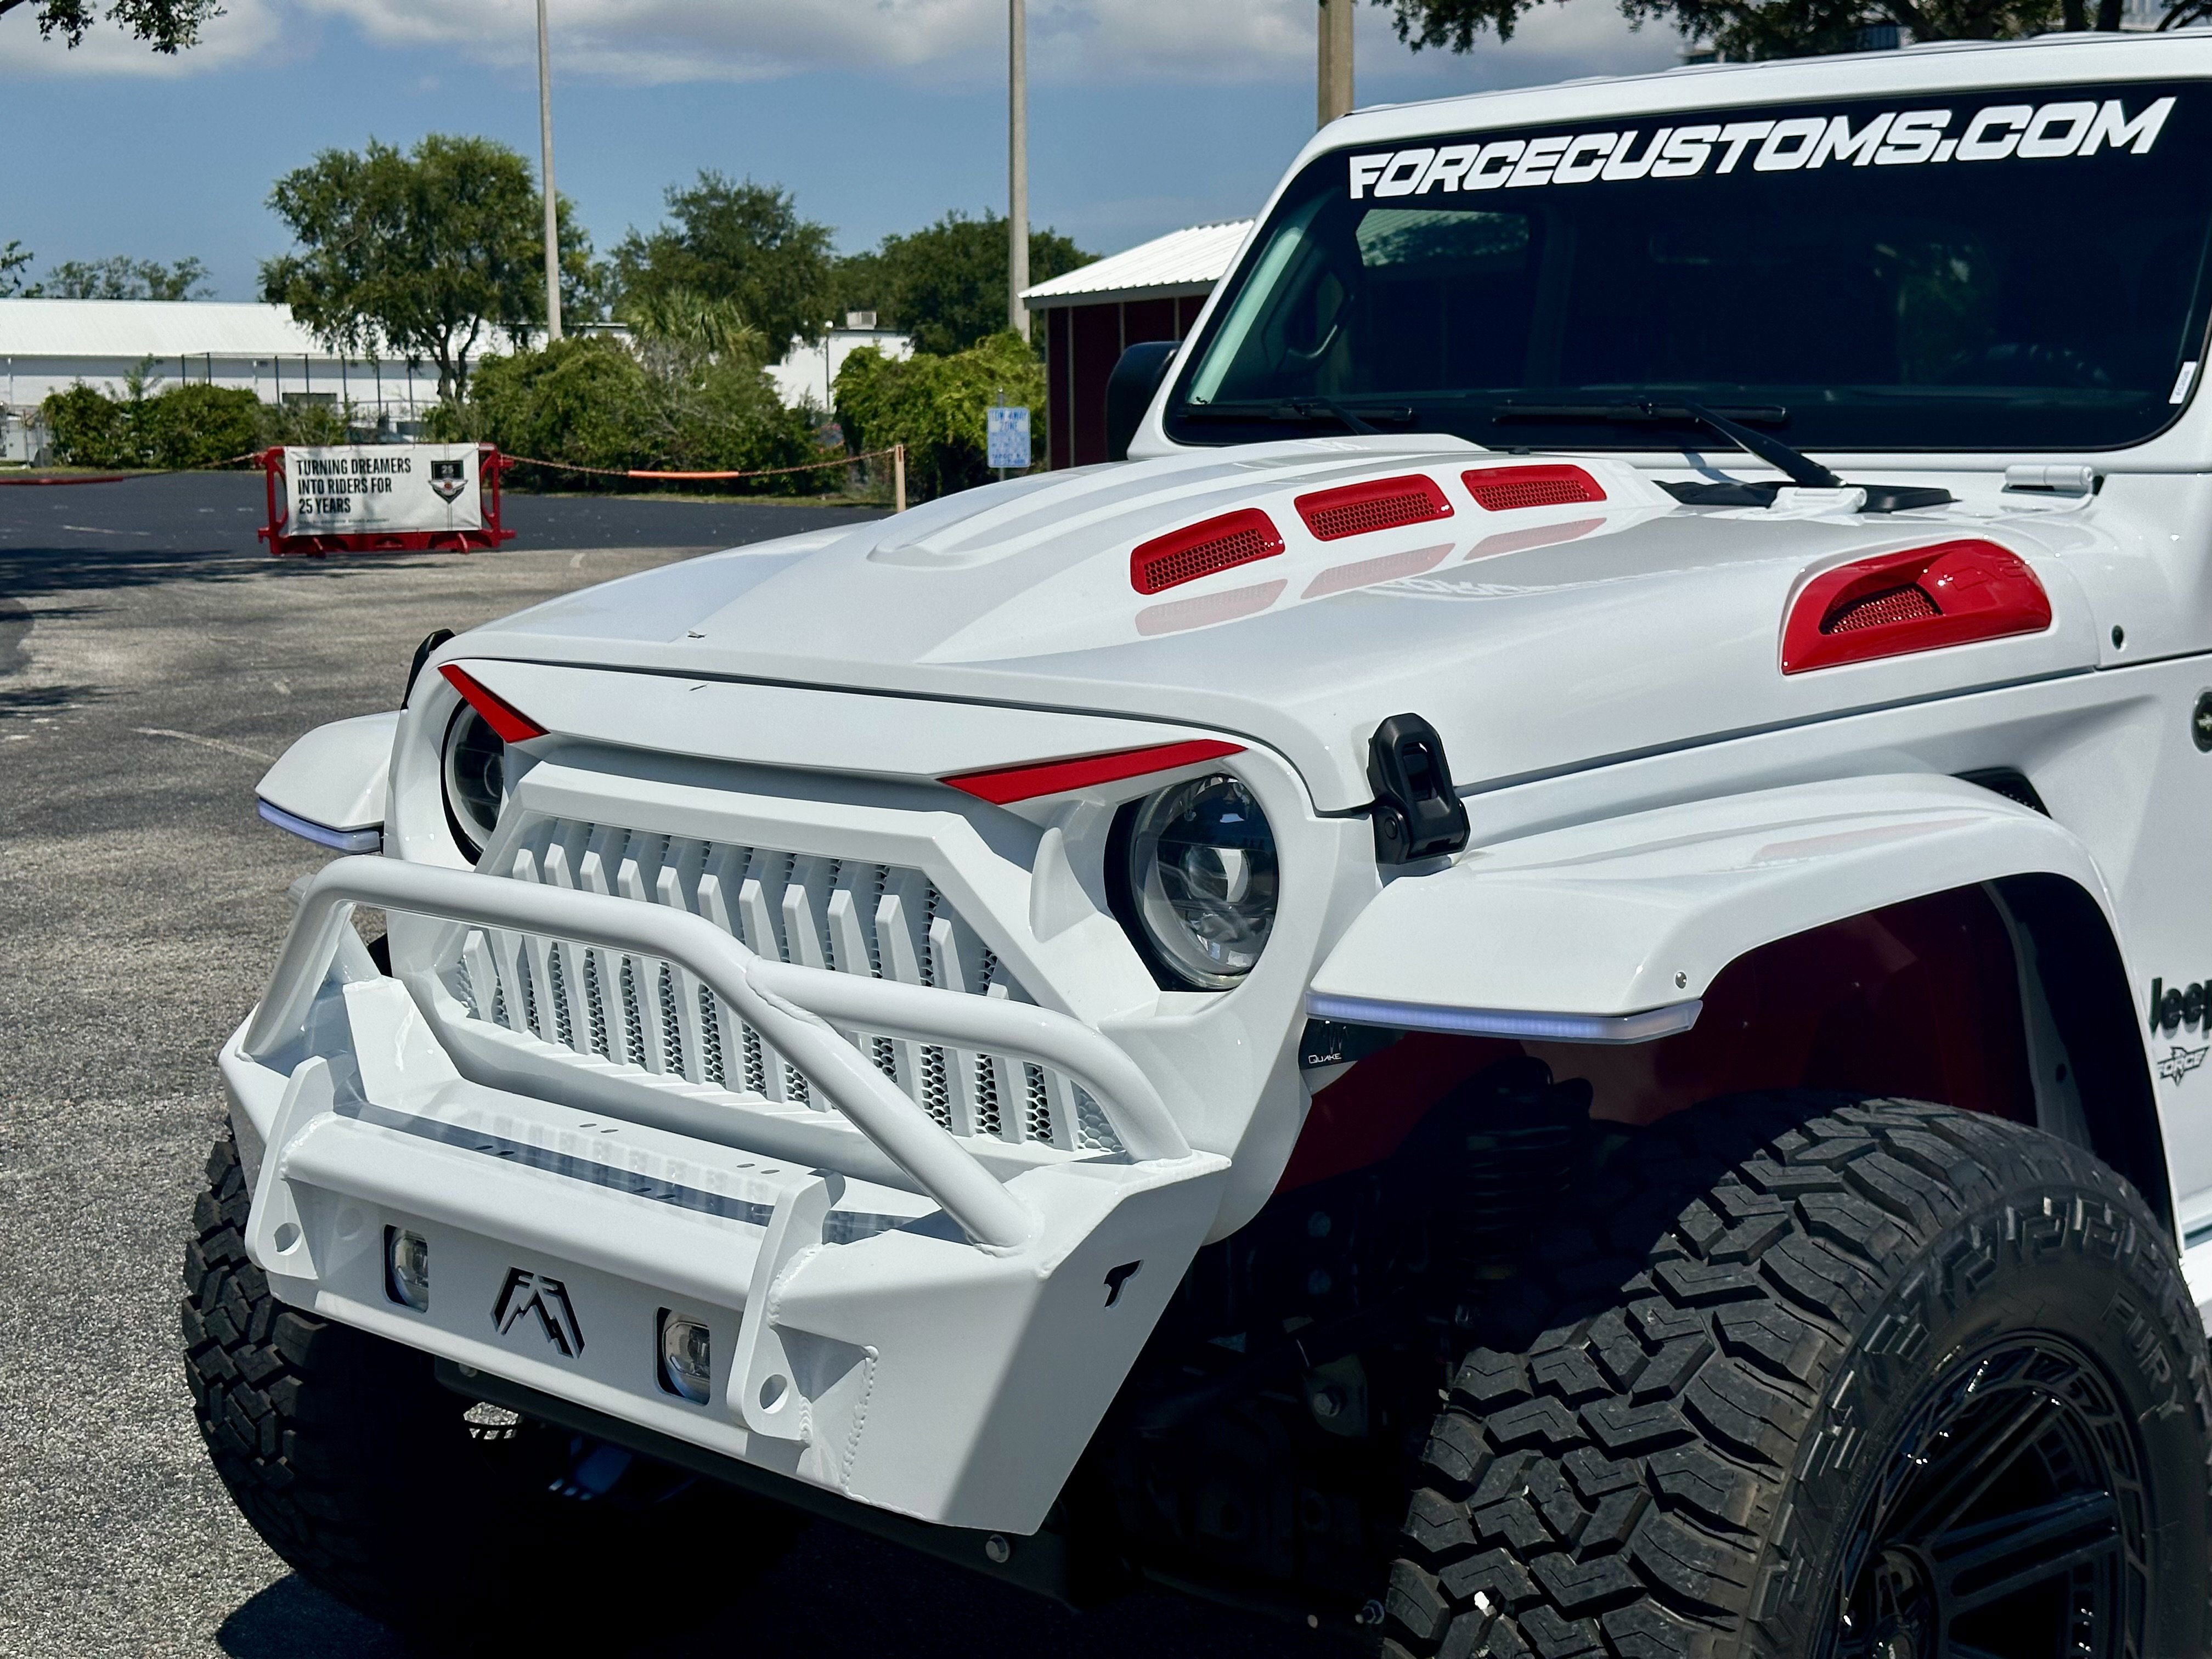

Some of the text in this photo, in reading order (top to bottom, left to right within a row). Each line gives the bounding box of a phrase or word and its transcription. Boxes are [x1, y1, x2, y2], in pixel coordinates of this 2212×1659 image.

[1349, 95, 2176, 200] FORCECUSTOMS.COM
[296, 458, 411, 476] TURNING DREAMERS
[441, 464, 454, 475] 25
[298, 477, 392, 495] INTO RIDERS FOR
[299, 498, 351, 514] 25 YEARS
[2099, 1289, 2185, 1421] FURY
